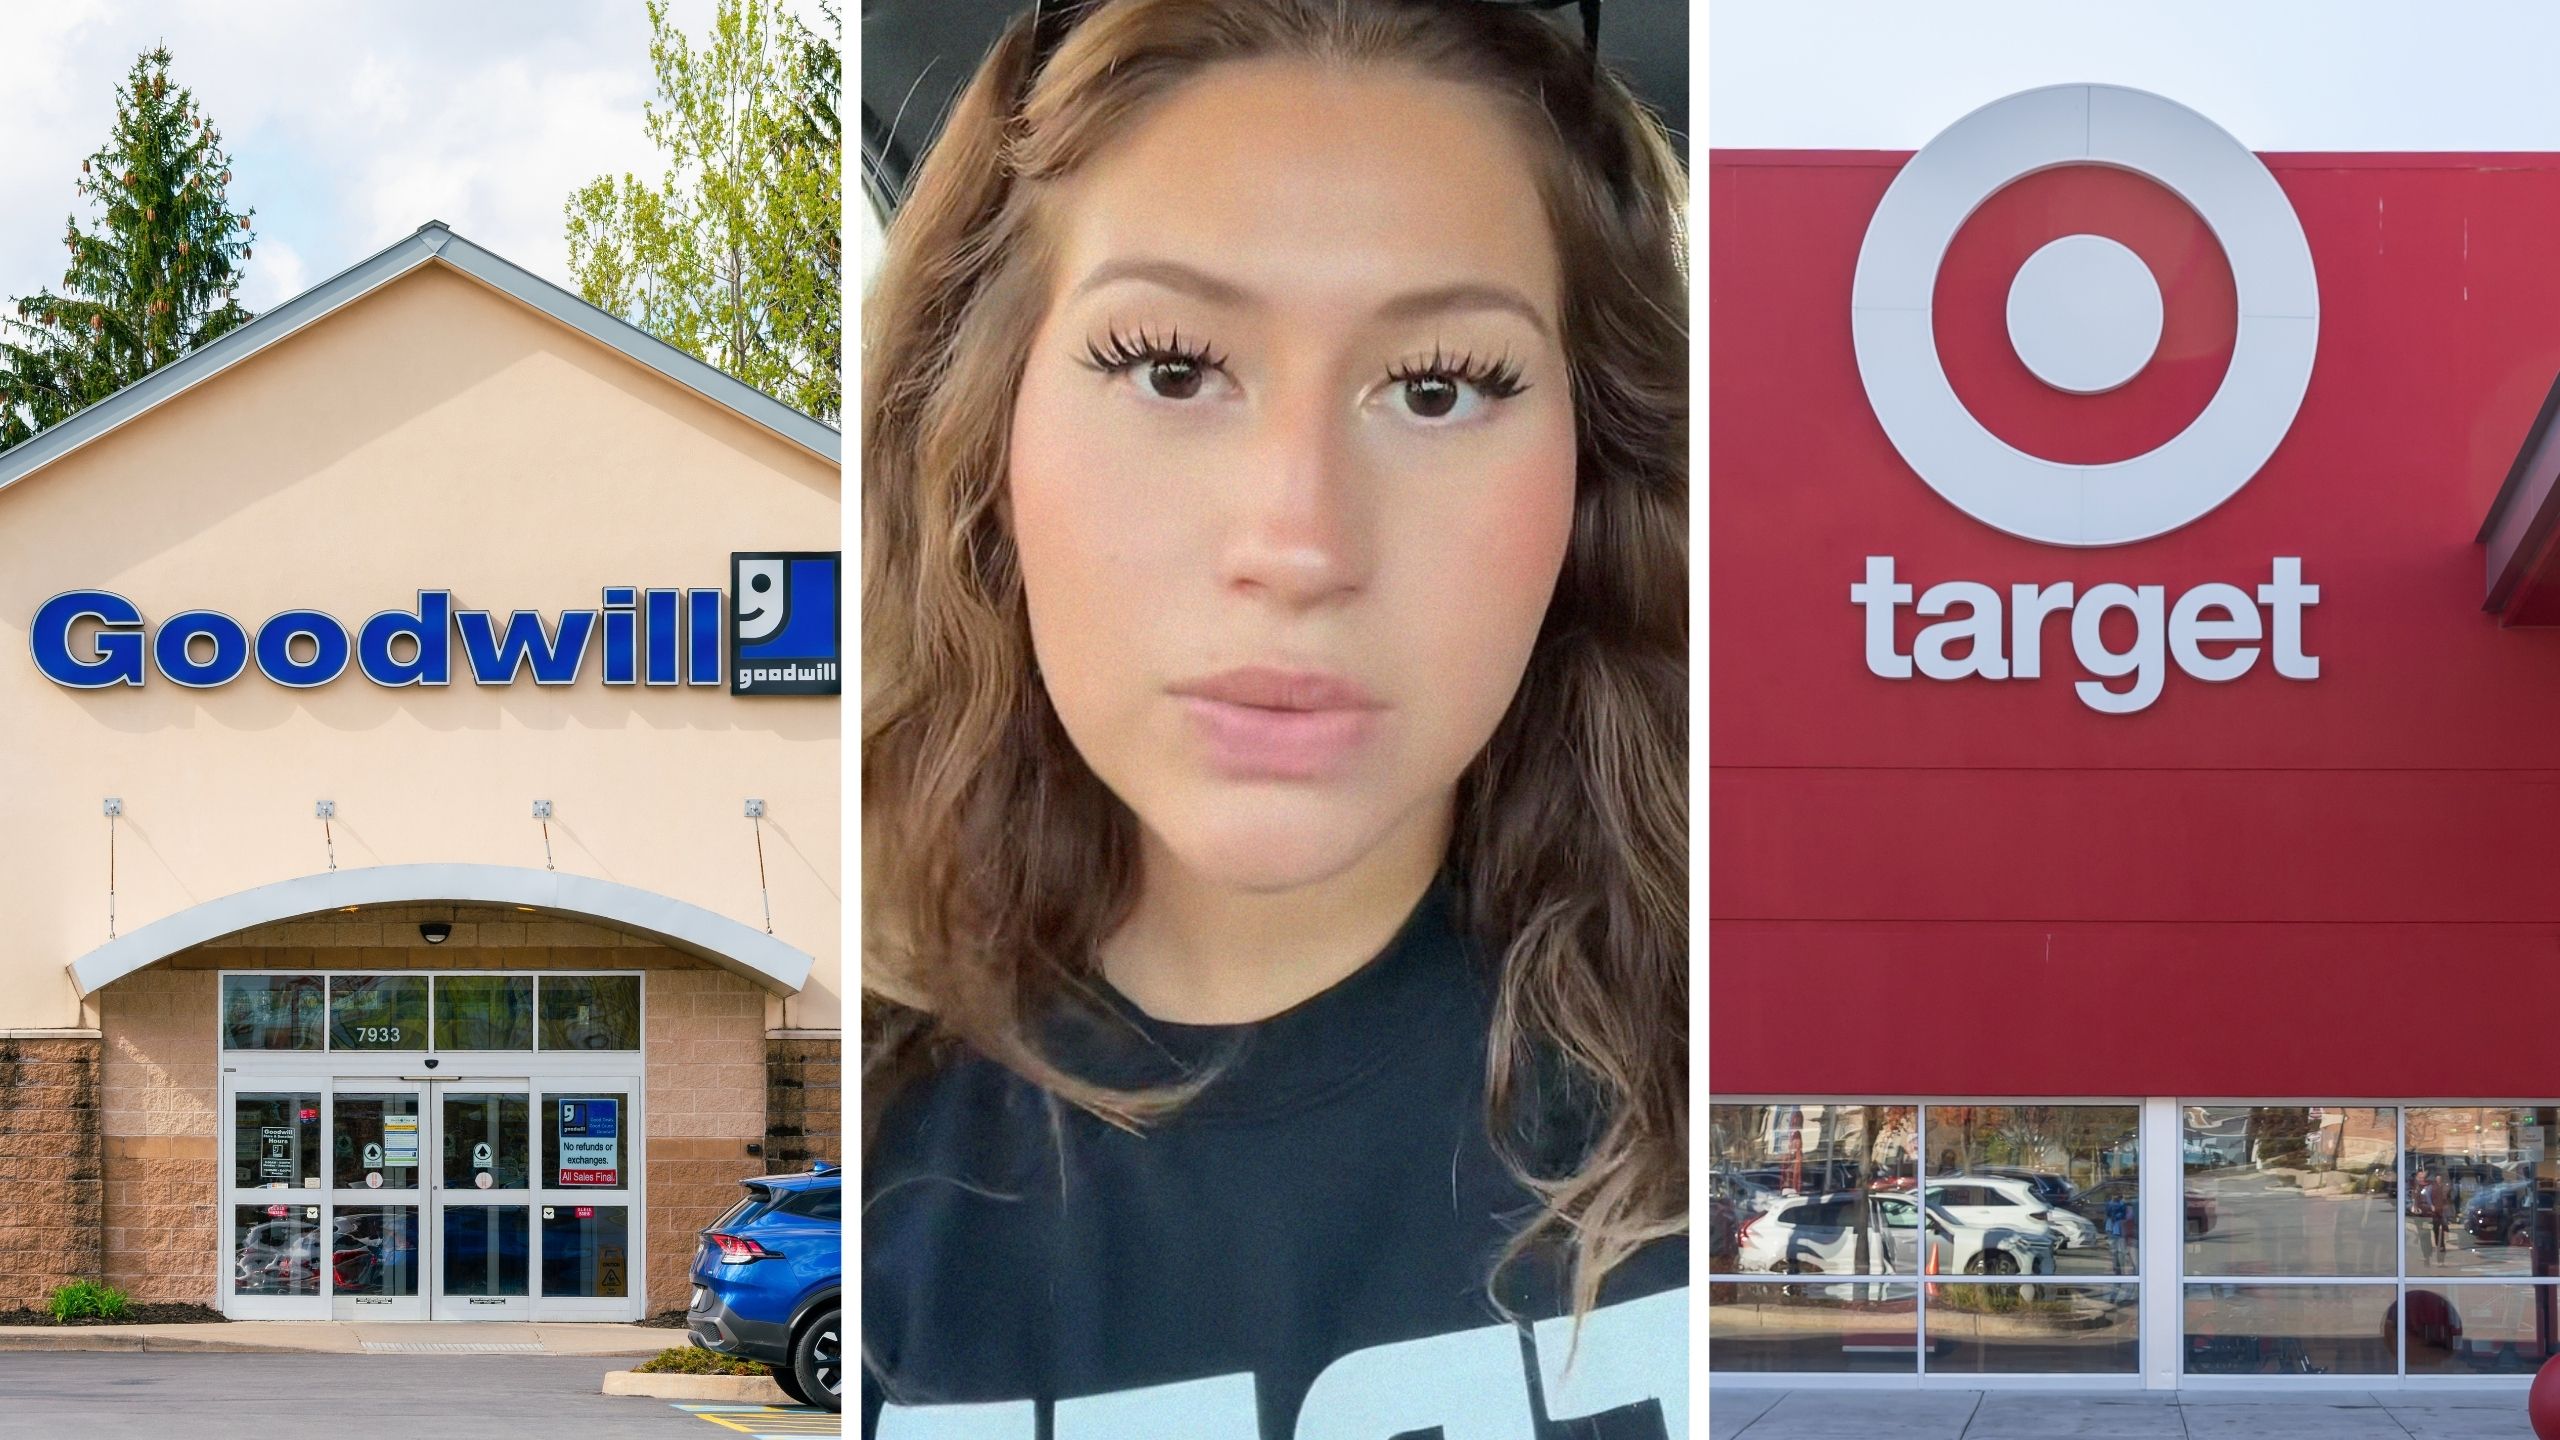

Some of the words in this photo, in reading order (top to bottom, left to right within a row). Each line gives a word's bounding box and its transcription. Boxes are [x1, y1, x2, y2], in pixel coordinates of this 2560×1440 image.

[29, 588, 723, 688] Goodwill
[1850, 555, 2320, 714] target
[739, 663, 836, 689] goodwill
[356, 1027, 401, 1042] 7933
[563, 1142, 574, 1151] No
[575, 1142, 604, 1151] refunds
[567, 1156, 609, 1166] exchanges.
[562, 1171, 572, 1181] All
[573, 1171, 594, 1182] Sales
[595, 1172, 616, 1182] Final.
